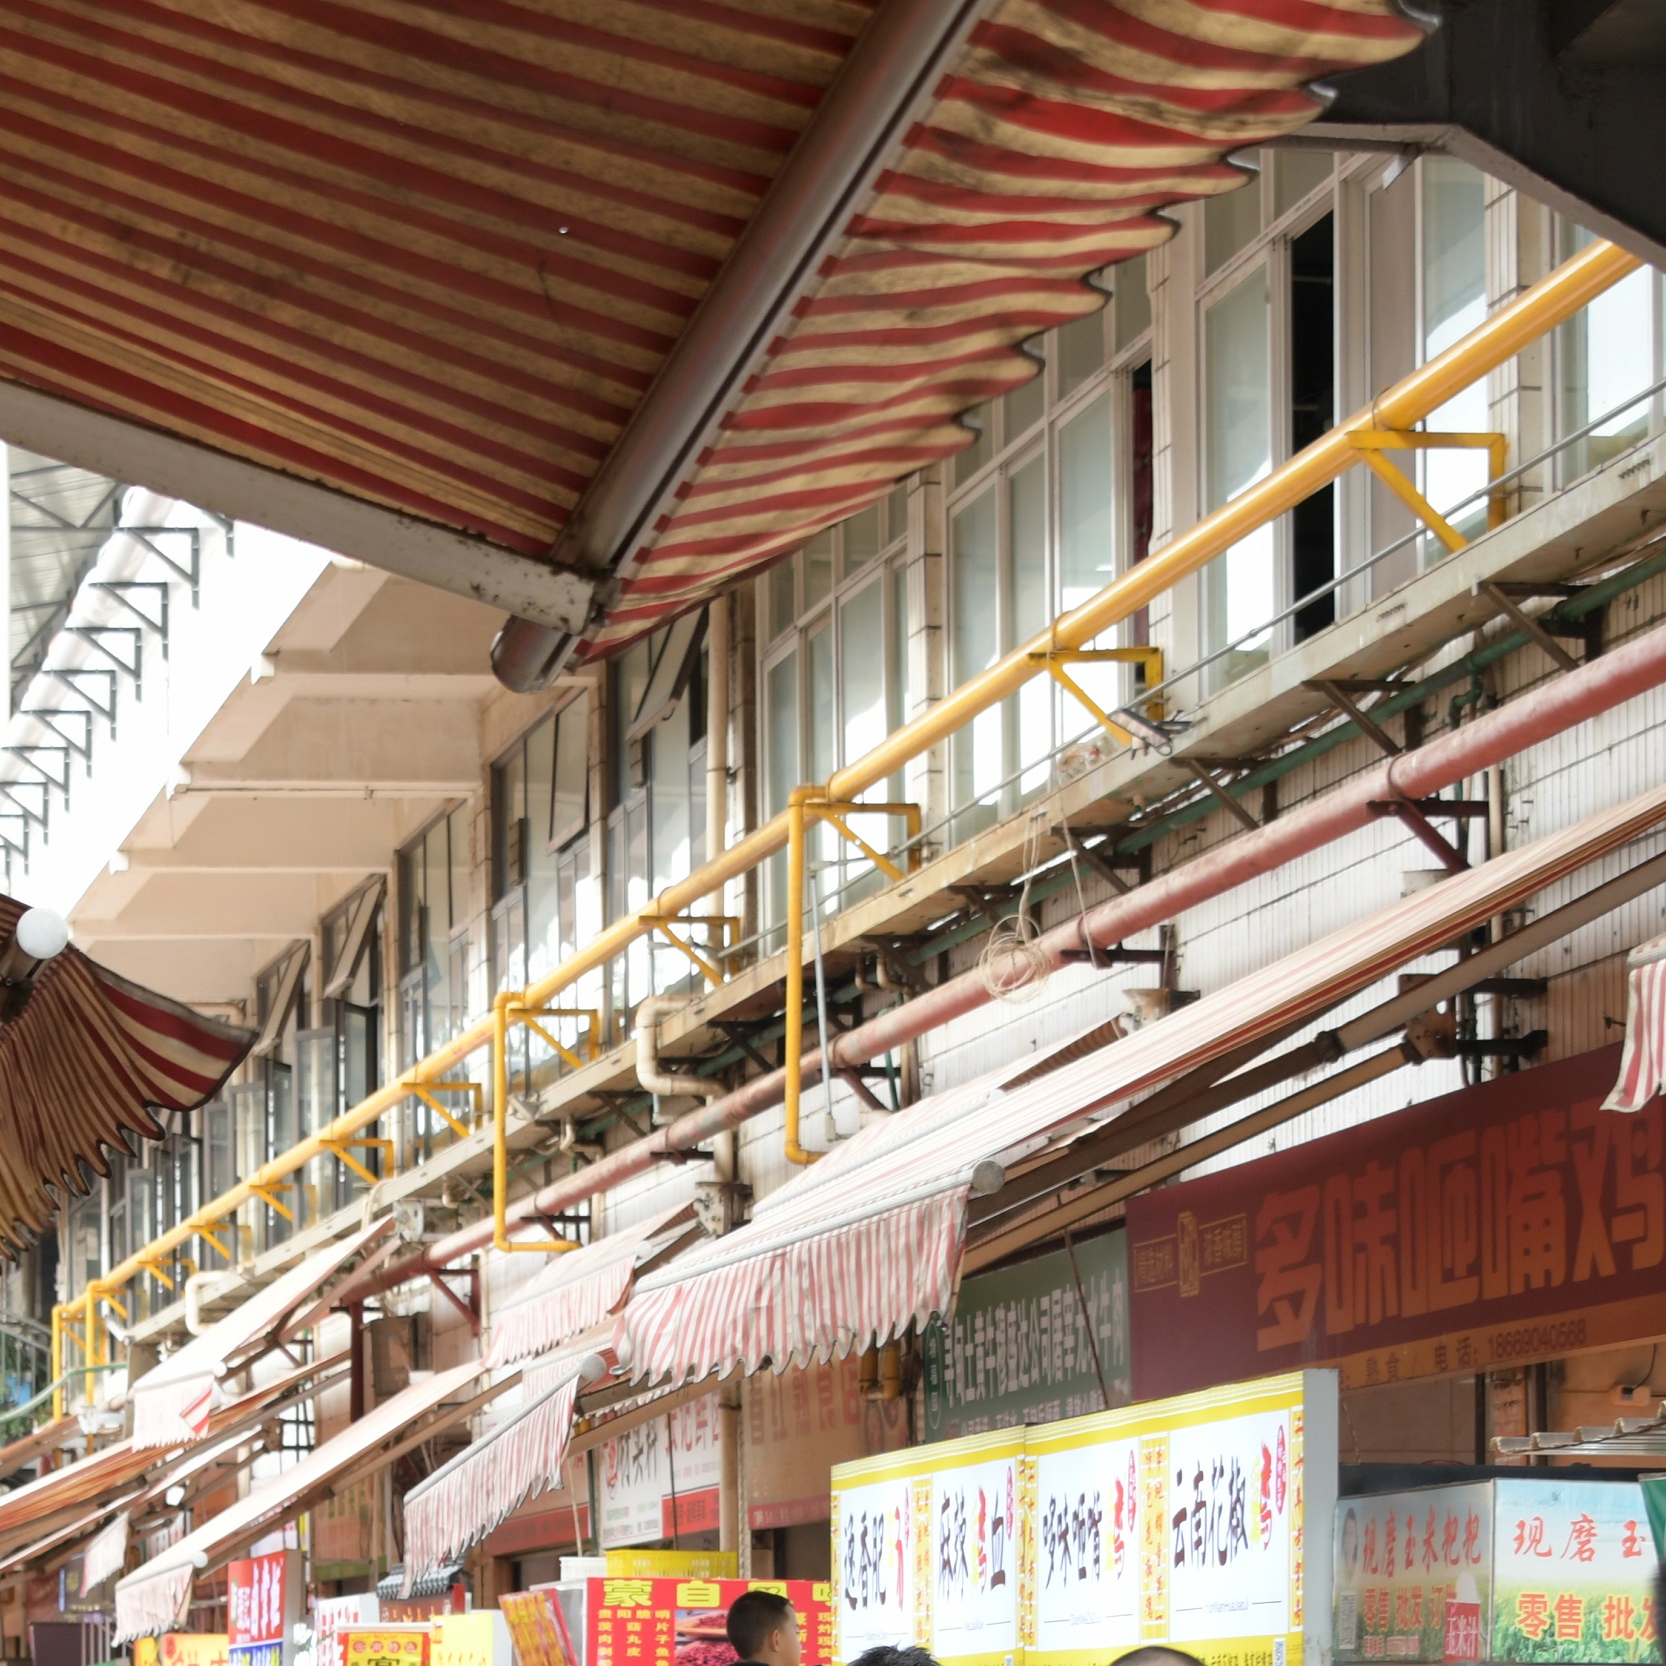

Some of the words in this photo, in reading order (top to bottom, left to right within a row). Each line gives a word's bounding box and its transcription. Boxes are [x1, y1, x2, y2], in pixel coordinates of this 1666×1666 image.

[1362, 1504, 1482, 1578] 现磨玉米粑粑
[1364, 1588, 1390, 1630] 零售
[1396, 1584, 1422, 1629] 批发
[1517, 1592, 1583, 1640] 零售
